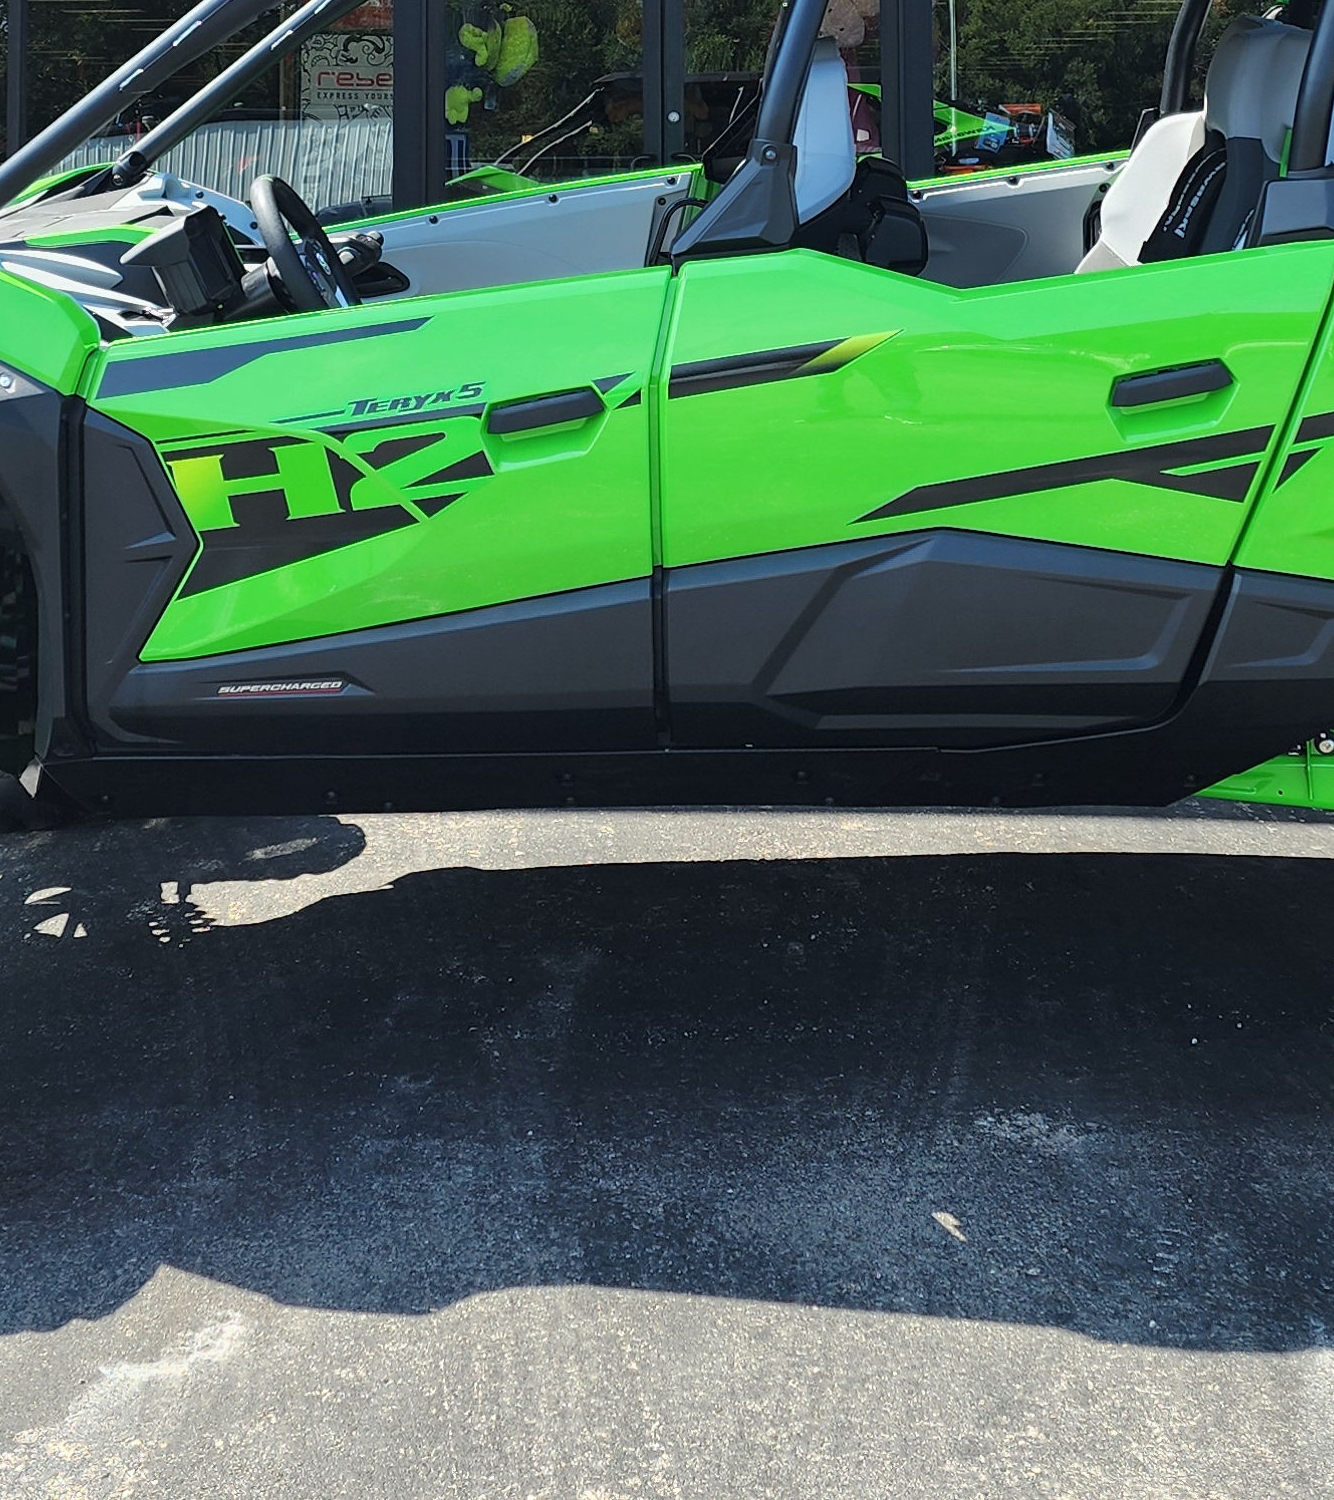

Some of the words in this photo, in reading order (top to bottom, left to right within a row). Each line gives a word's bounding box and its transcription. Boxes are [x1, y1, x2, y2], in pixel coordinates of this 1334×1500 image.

[317, 71, 394, 87] rebe
[317, 92, 359, 100] EXPRESS
[364, 92, 394, 100] YOURS
[217, 681, 343, 695] SUPERCHARGED
